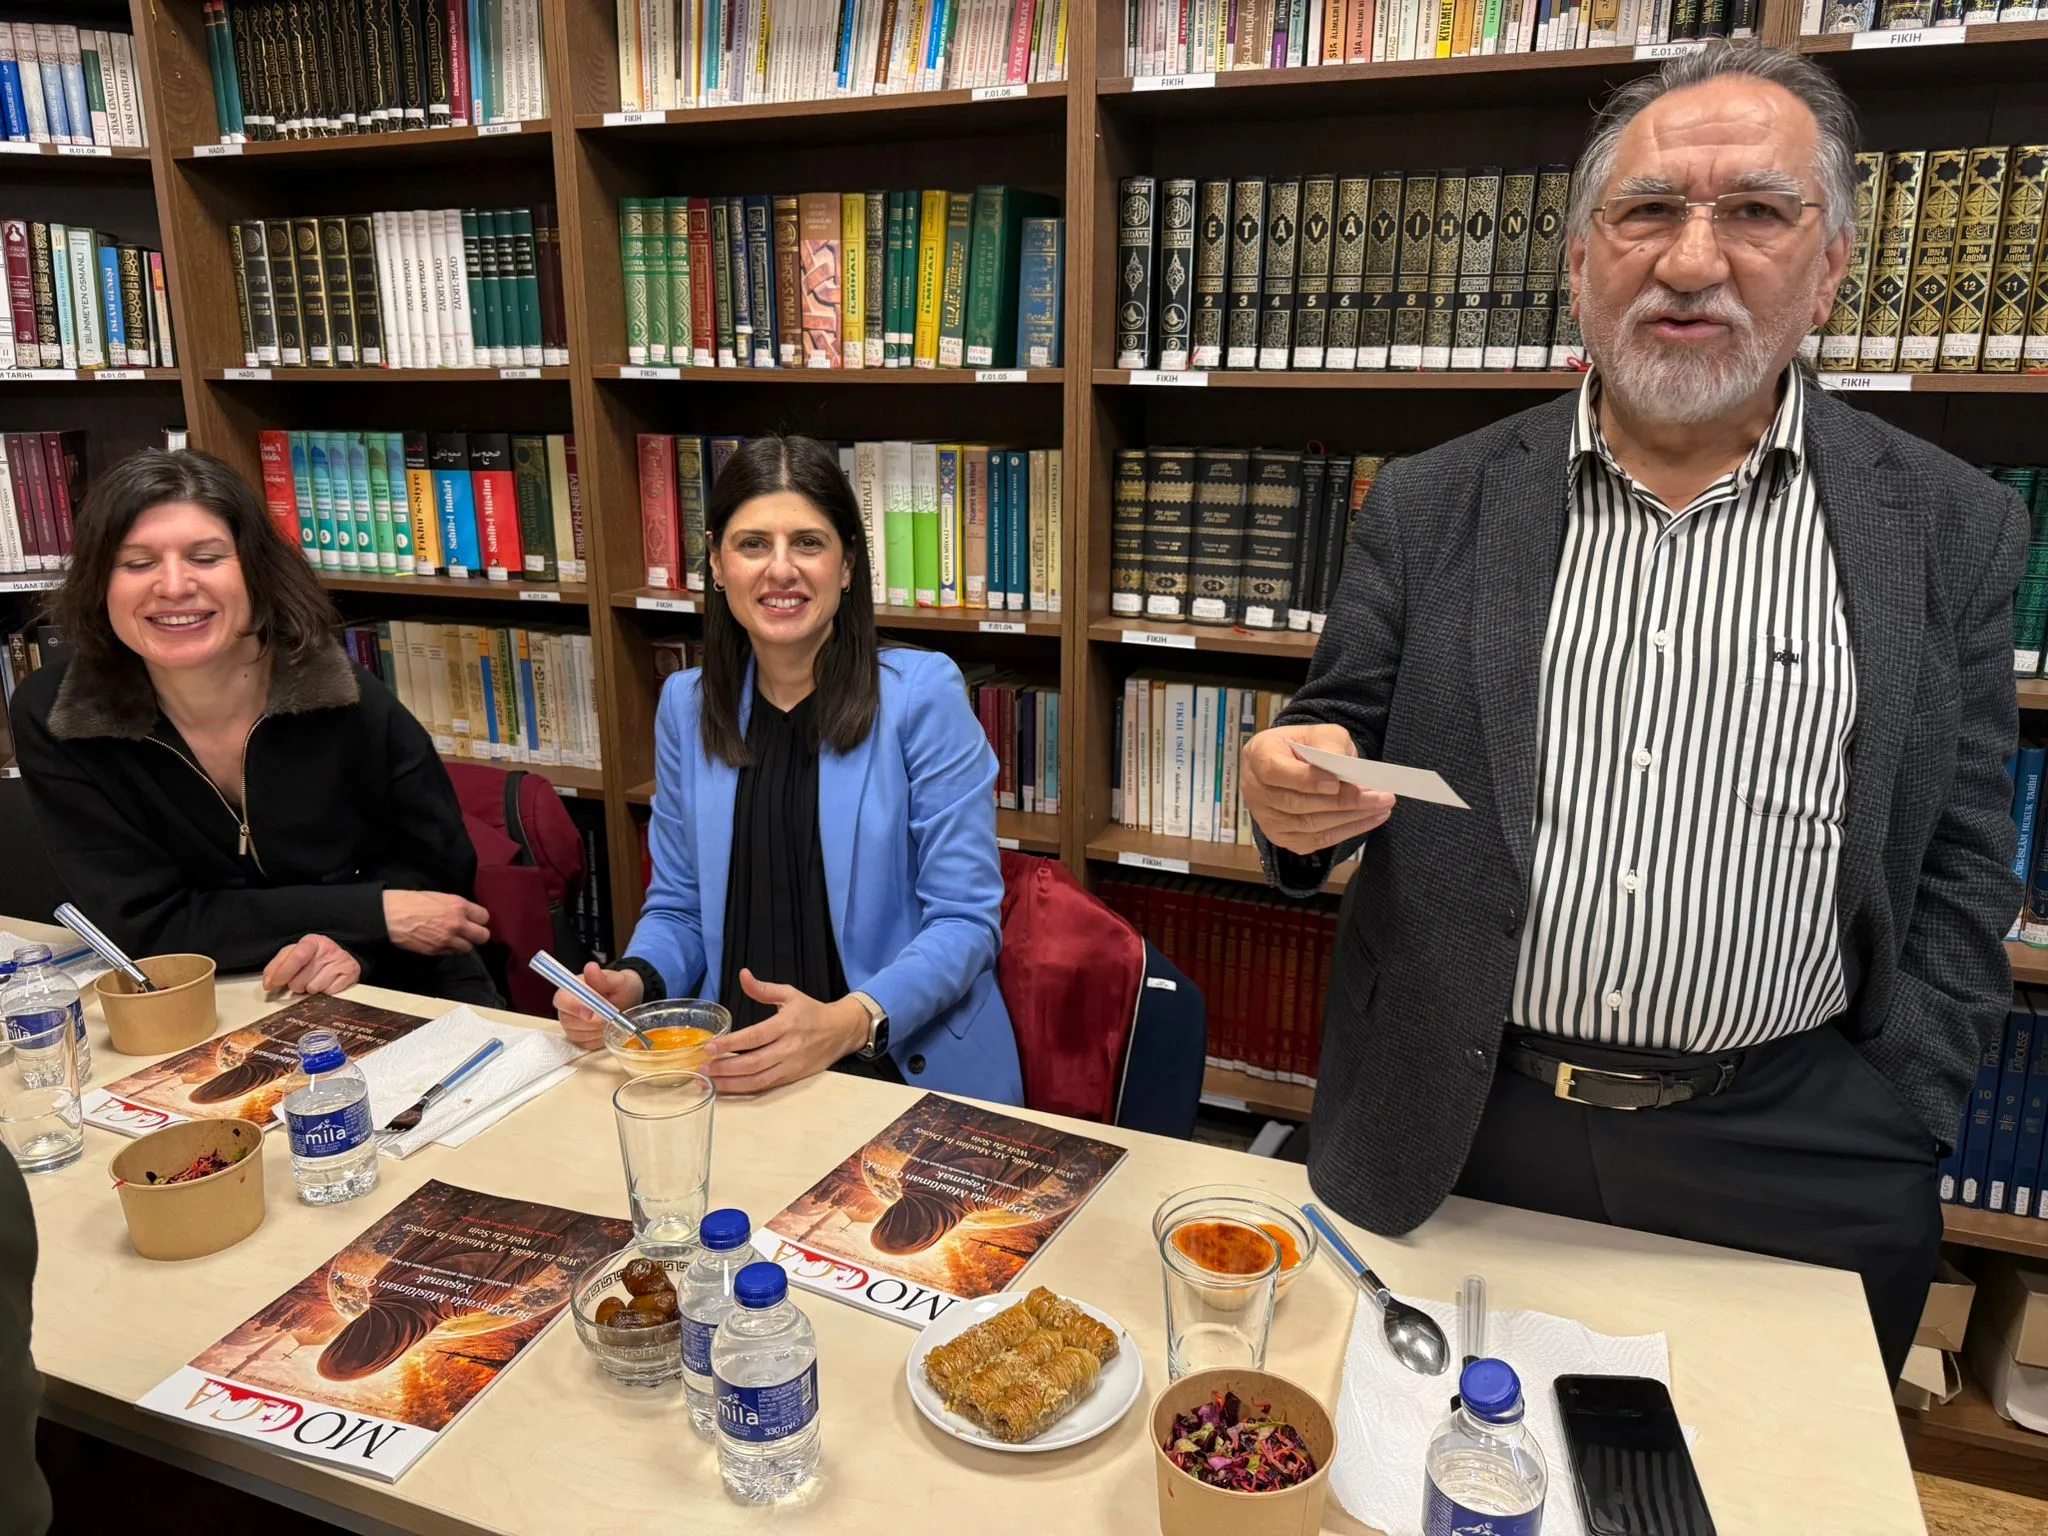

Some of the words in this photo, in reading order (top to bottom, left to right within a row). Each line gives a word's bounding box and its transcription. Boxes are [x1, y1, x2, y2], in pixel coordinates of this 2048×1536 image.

[1016, 1, 1029, 43] NAMAZ
[1438, 2, 1453, 41] KIYAMET
[1890, 33, 1922, 44] FIKIH
[1328, 43, 1337, 58] ŞİA
[1353, 41, 1363, 55] ŞİA
[1014, 46, 1023, 74] TAM
[104, 66, 117, 110] CİNAYETLER
[1161, 78, 1184, 87] FIKIH
[120, 69, 131, 111] CİNAYETLER
[1208, 222, 1216, 238] E
[1243, 222, 1252, 238] T
[1276, 220, 1287, 239] Â
[1311, 222, 1323, 238] V
[1345, 216, 1357, 236] Â
[1378, 220, 1389, 236] Y
[1441, 220, 1454, 237] H
[1508, 216, 1521, 234] N
[1543, 215, 1555, 232] D
[77, 252, 87, 292] OSMANLI
[105, 268, 115, 301] GÜNEŞİ
[1840, 284, 1852, 293] 15
[1881, 284, 1893, 293] 14
[1924, 284, 1937, 293] 13
[1962, 282, 1976, 290] 12
[2006, 282, 2018, 290] 11
[1204, 296, 1213, 307] 2
[1240, 296, 1248, 306] 3
[1272, 296, 1280, 306] 4
[1307, 296, 1316, 306] 5
[1340, 295, 1350, 306] 6
[1373, 295, 1383, 306] 7
[1406, 294, 1416, 306] 8
[1435, 296, 1445, 307] 9
[1465, 294, 1480, 306] 10
[1501, 294, 1512, 305] 11
[1533, 293, 1548, 304] 12
[81, 293, 92, 344] BİLİNMEYEN
[108, 304, 118, 332] İSLAM
[1128, 338, 1134, 346] 3
[1841, 378, 1870, 387] FIKIH
[483, 479, 494, 514] Müslim
[970, 487, 976, 497] ve
[862, 480, 873, 532] İLMİHALİ
[968, 499, 976, 525] Ticaret
[12, 582, 37, 590] İSLAM
[1146, 635, 1167, 643] FIKIH
[1176, 702, 1184, 731] FIKIH
[2026, 774, 2038, 800] TARİHİ
[2022, 803, 2033, 831] HUKUK
[1142, 858, 1162, 866] FIKIH
[2012, 1030, 2029, 1072] LAROUSSE
[1979, 1089, 1992, 1100] 10
[2006, 1095, 2014, 1105] 9
[2032, 1098, 2040, 1107] 8
[305, 1128, 346, 1144] mila
[350, 1136, 360, 1144] 330
[912, 1127, 943, 1142] Dieser
[944, 1136, 954, 1145] In
[970, 1135, 992, 1146] Sein
[955, 1140, 991, 1155] Muslim
[994, 1141, 1007, 1150] Zu
[1008, 1146, 1029, 1157] Welt
[992, 1151, 1010, 1161] Als
[1011, 1156, 1039, 1170] Heißt,
[1041, 1164, 1054, 1173] Es
[864, 1160, 904, 1180] Olarak
[1055, 1167, 1076, 1179] Was
[905, 1173, 968, 1199] Müslüman
[936, 1170, 988, 1193] Yaşamak
[971, 1193, 1027, 1216] Dünyada
[1029, 1210, 1046, 1221] Bu
[401, 1223, 436, 1238] Dieser
[438, 1231, 448, 1240] In
[468, 1226, 492, 1237] Sein
[493, 1232, 508, 1241] Zu
[449, 1234, 487, 1250] Muslim
[510, 1236, 532, 1246] Welt
[488, 1242, 508, 1254] Als
[510, 1246, 540, 1260] Heißt,
[542, 1252, 554, 1262] Es
[556, 1253, 578, 1267] Was
[332, 1270, 378, 1288] Olarak
[415, 1274, 474, 1294] Yaşamak
[772, 1240, 960, 1320] MOCCA
[378, 1280, 448, 1303] Müslüman
[444, 1294, 512, 1316] Dünyada
[516, 1308, 533, 1320] Bu
[185, 1377, 406, 1460] MOCCA
[718, 1400, 759, 1425] mila
[765, 1428, 780, 1436] 330
